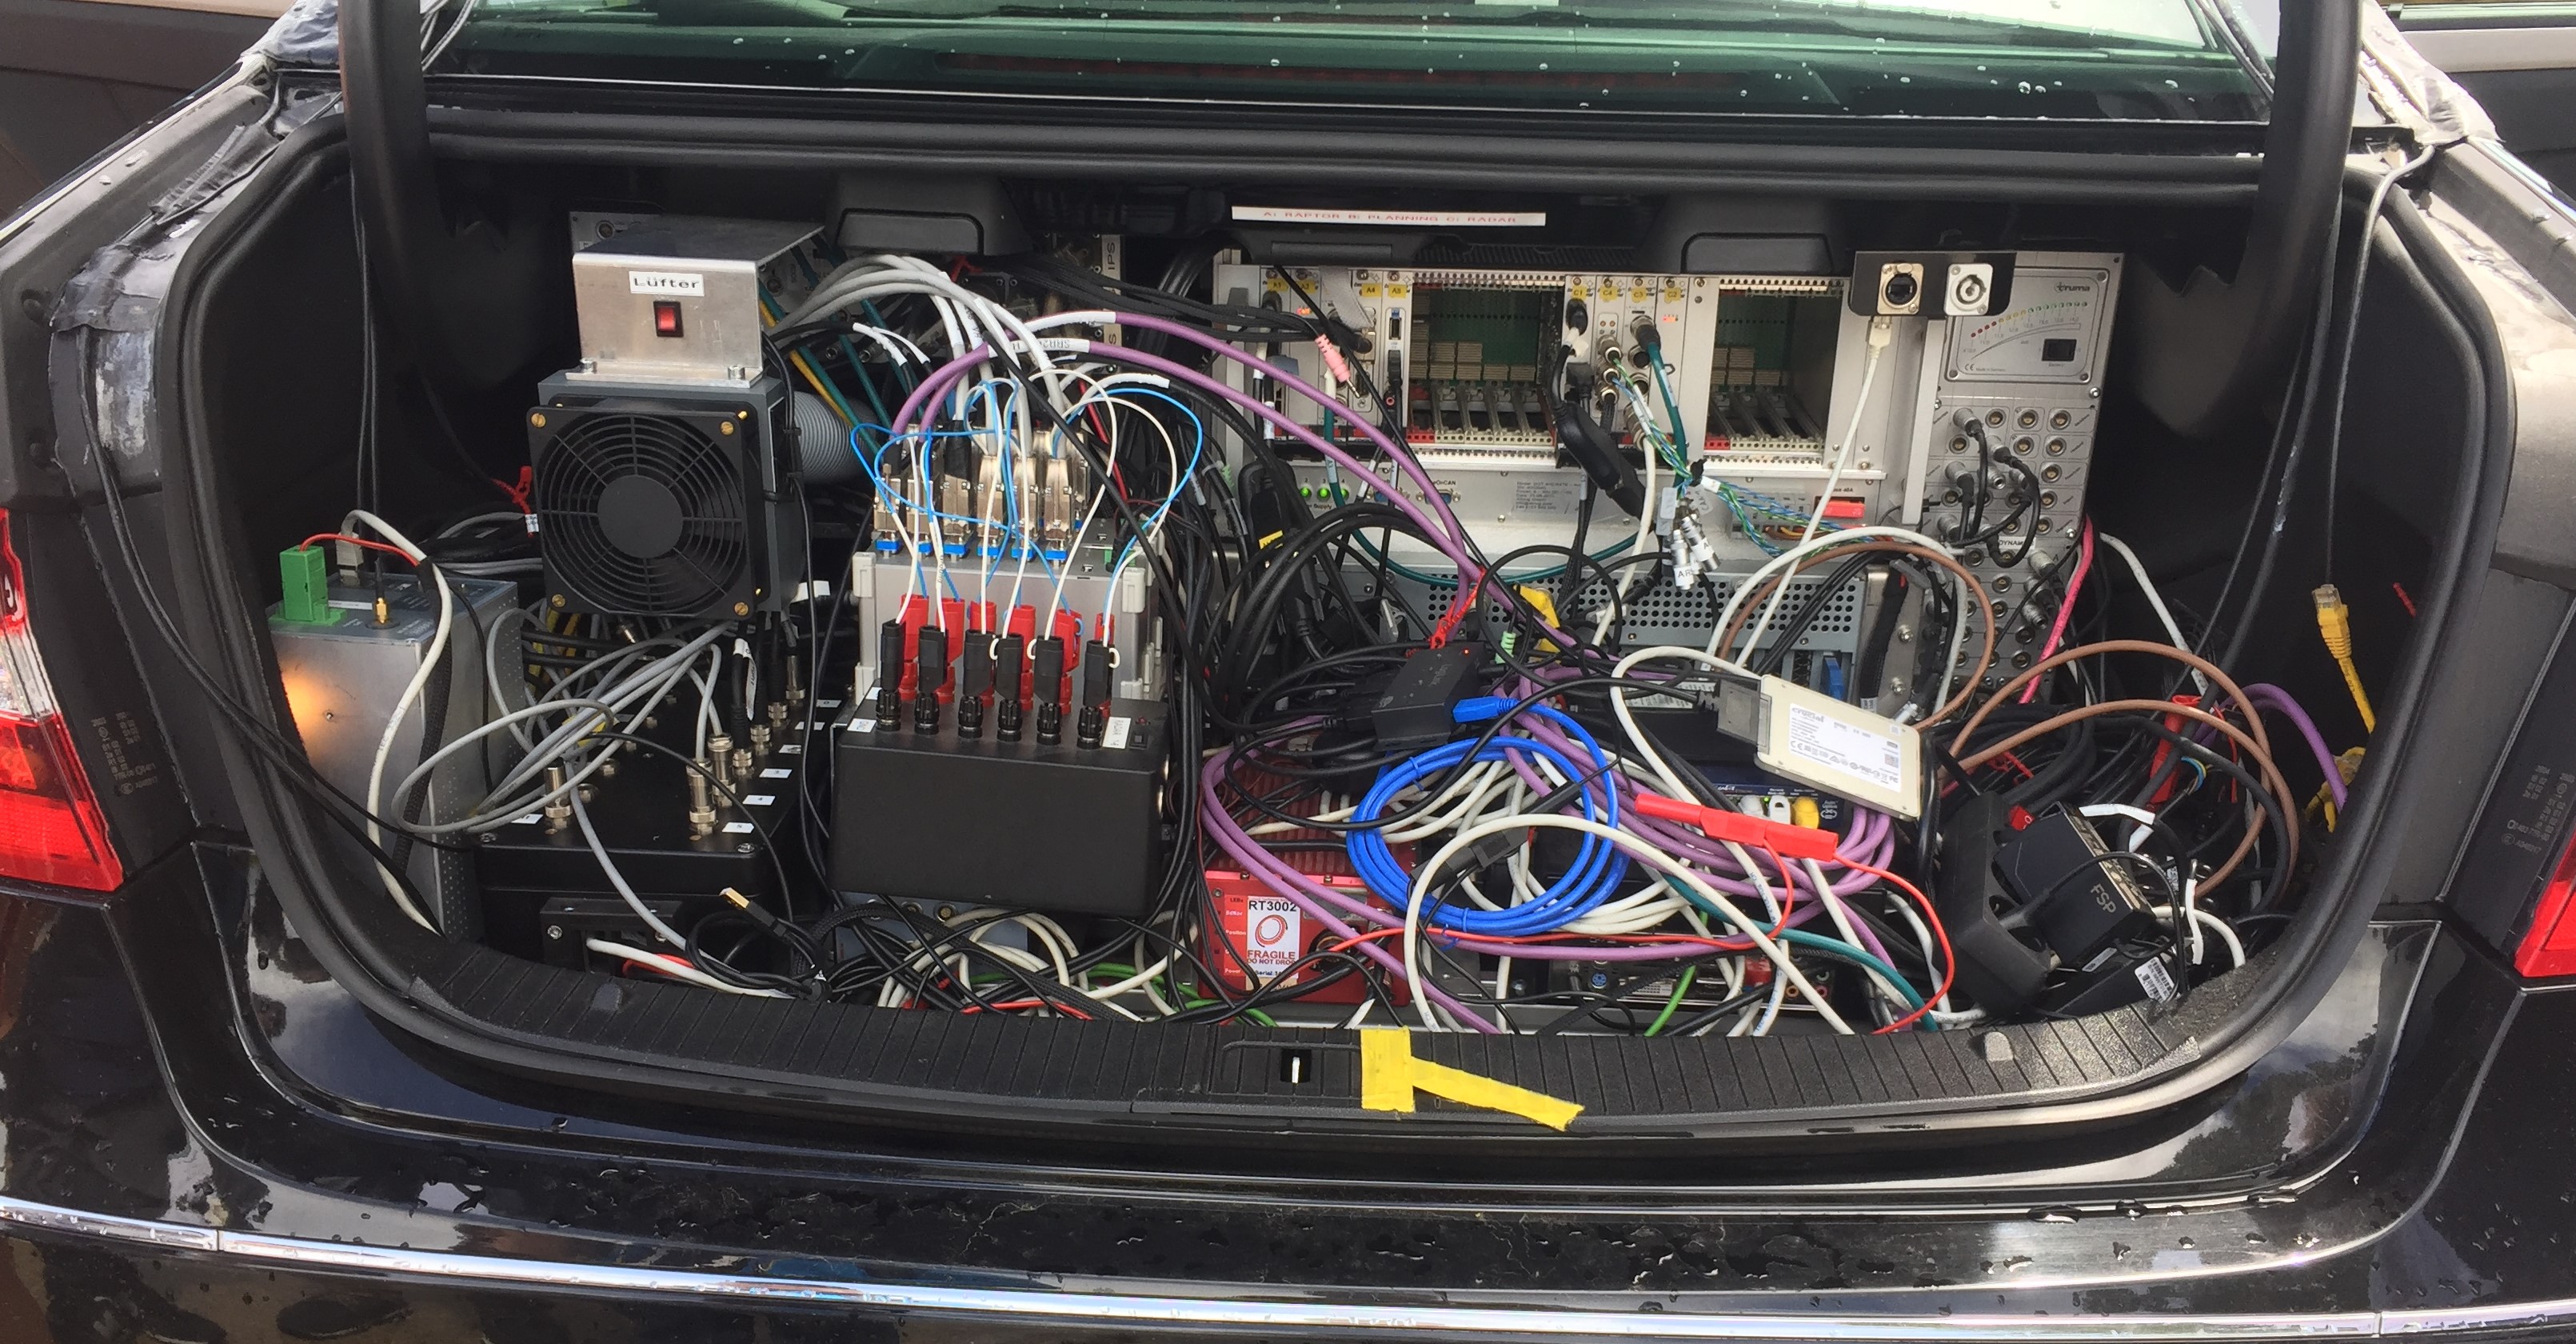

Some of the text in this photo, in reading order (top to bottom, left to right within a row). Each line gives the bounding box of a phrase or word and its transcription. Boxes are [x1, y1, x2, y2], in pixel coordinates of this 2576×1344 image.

[1368, 214, 1439, 222] PLANNING
[1107, 242, 1116, 270] IPS
[633, 277, 700, 289] Lüfter
[1791, 707, 1825, 723] crucial
[2090, 883, 2117, 914] FSP
[1248, 901, 1297, 912] RT3002
[1248, 950, 1296, 959] FRAGILE
